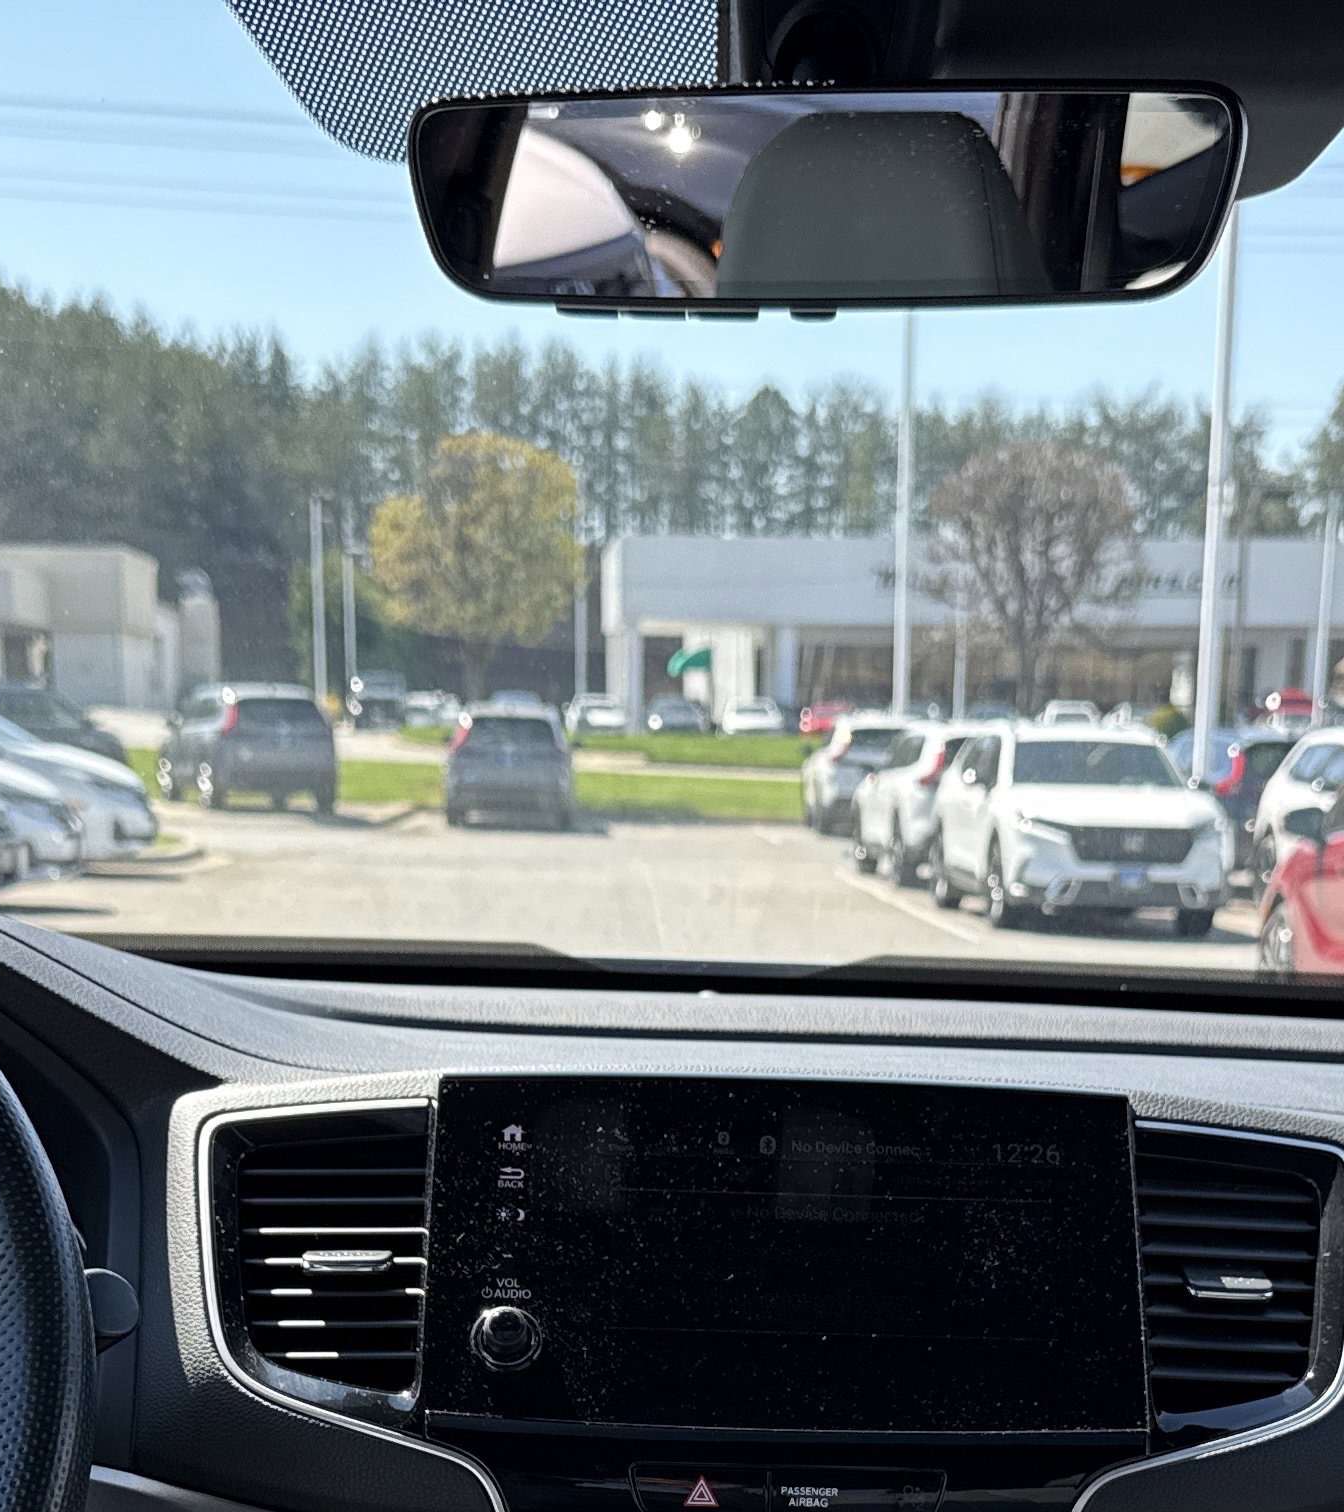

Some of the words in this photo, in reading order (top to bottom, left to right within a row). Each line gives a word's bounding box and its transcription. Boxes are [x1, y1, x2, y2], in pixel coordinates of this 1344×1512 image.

[498, 1142, 527, 1150] HOME
[992, 1144, 1060, 1165] 12:26
[498, 1180, 524, 1188] BACK
[496, 1278, 521, 1288] VOL
[494, 1289, 532, 1299] AUDIO
[781, 1486, 839, 1497] PASSENGER
[788, 1497, 829, 1508] AIRBAG
